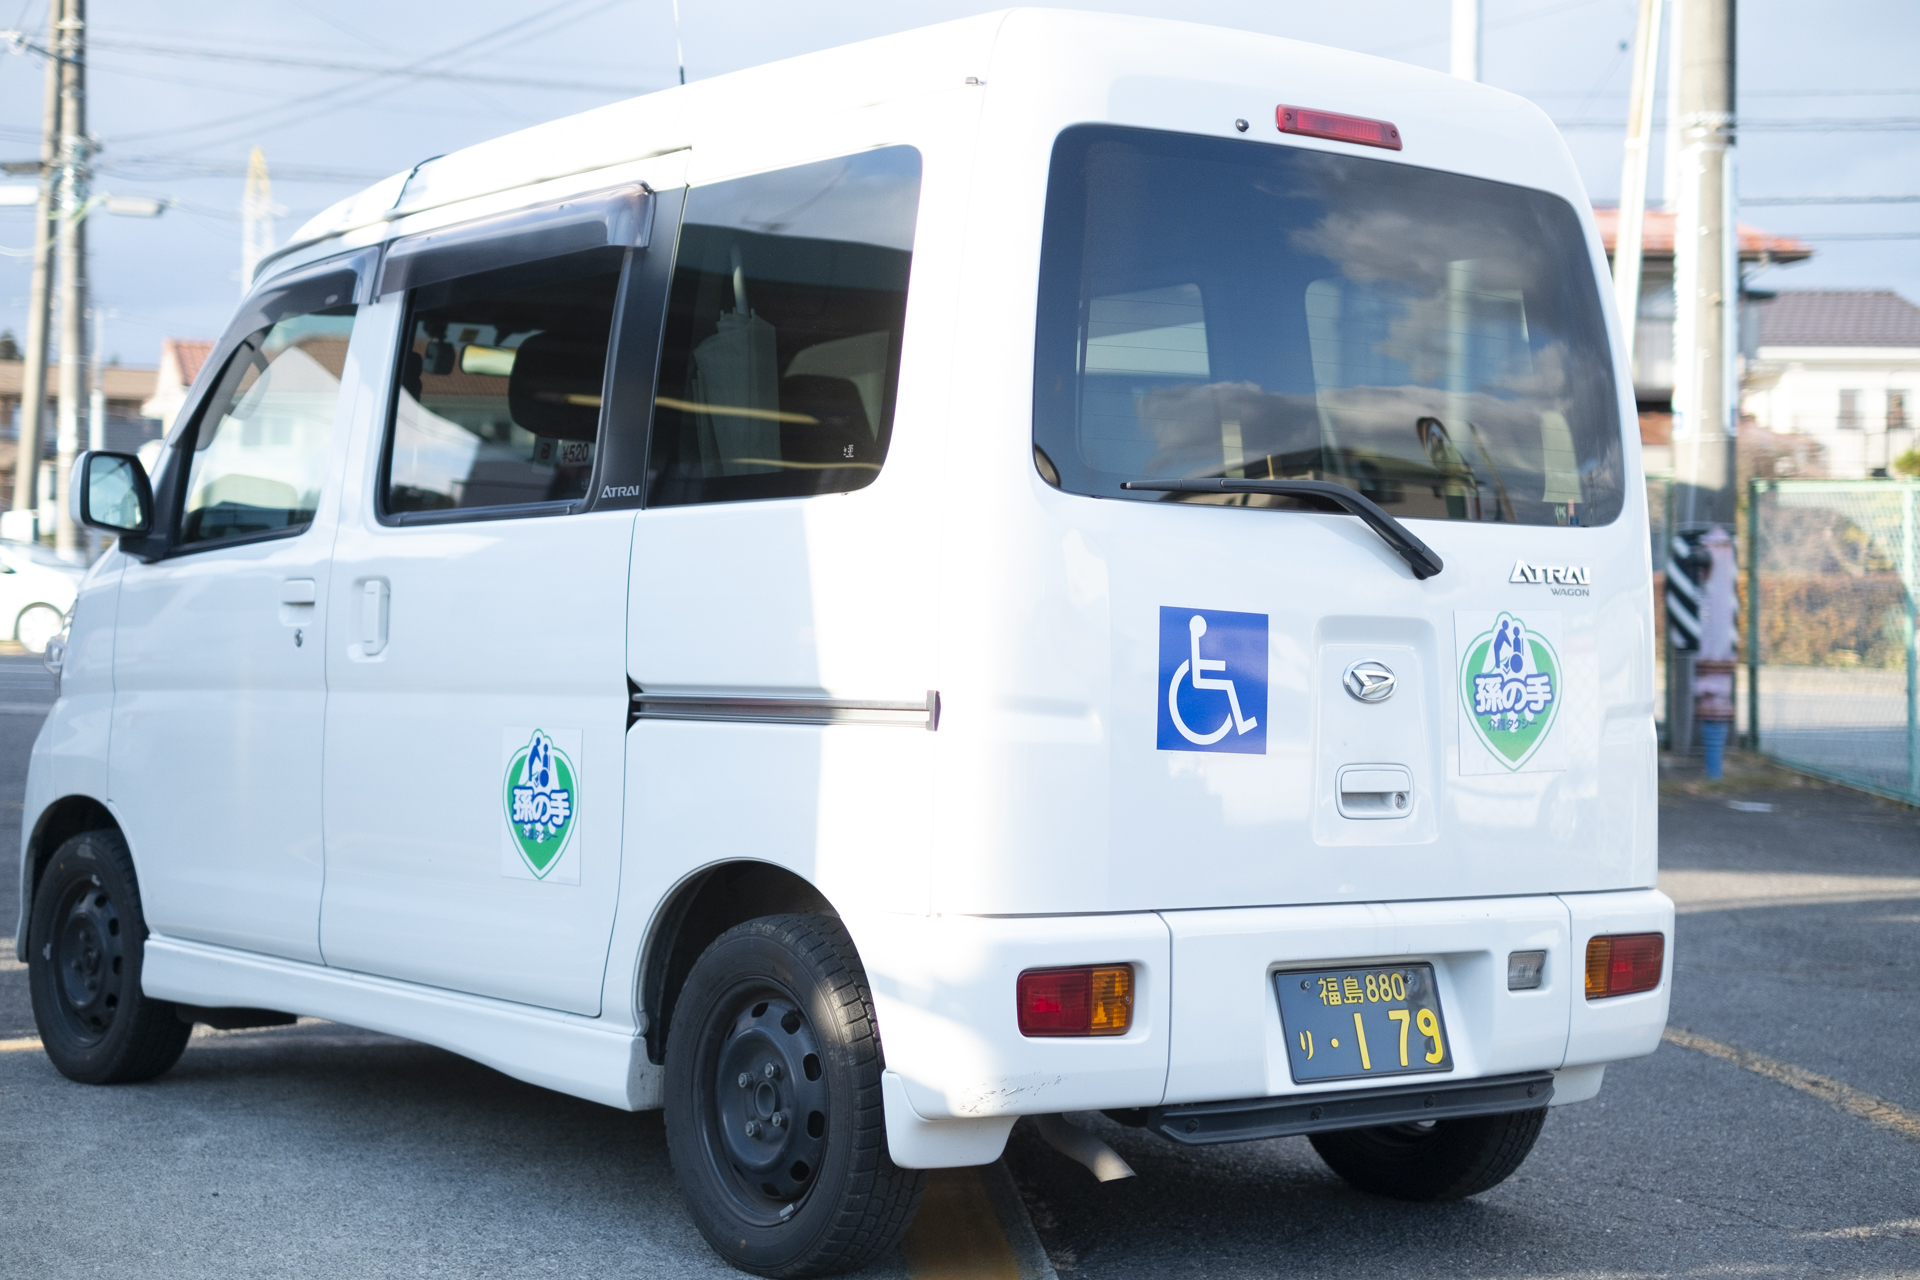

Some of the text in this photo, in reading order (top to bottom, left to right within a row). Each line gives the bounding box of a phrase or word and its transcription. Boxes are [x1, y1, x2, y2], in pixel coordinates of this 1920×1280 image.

[601, 485, 639, 498] ATRAI
[1509, 559, 1590, 585] ATRAI
[1550, 588, 1589, 597] WAGON
[1474, 674, 1553, 714] 孫の手
[512, 786, 571, 827] 孫の手
